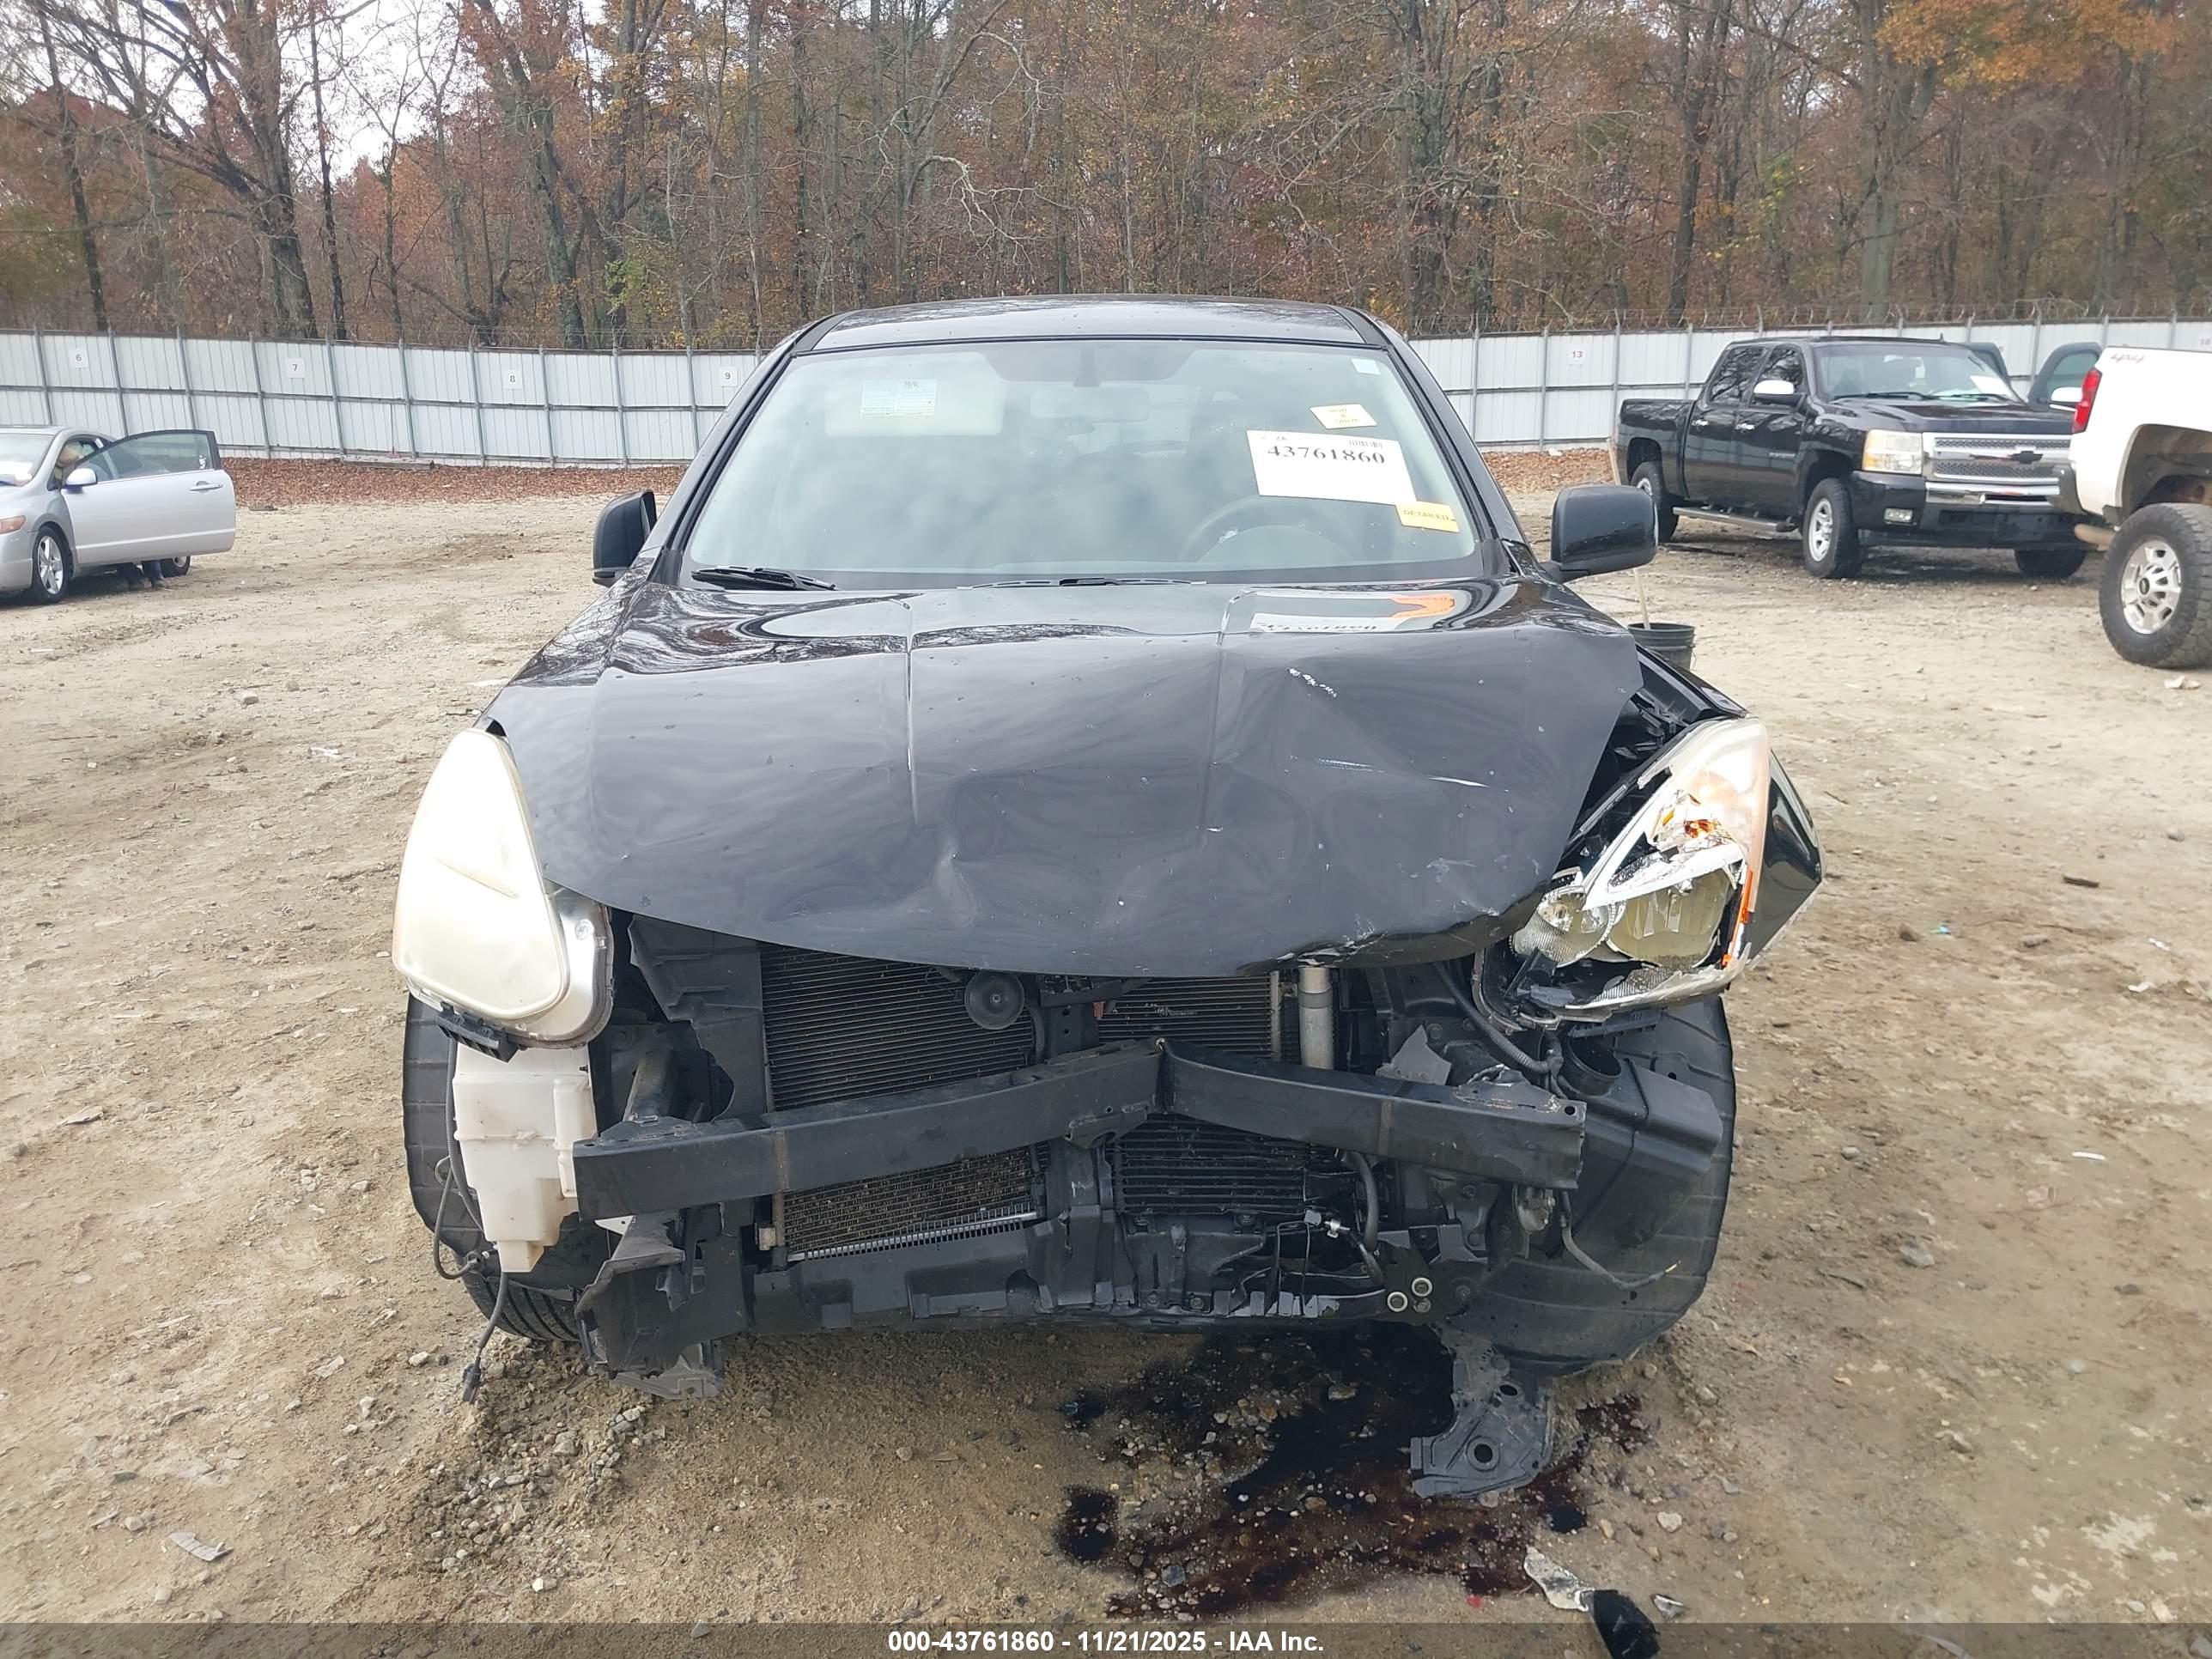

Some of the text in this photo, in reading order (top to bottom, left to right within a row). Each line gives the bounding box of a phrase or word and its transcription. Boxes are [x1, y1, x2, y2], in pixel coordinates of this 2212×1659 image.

[292, 363, 298, 372] 7
[509, 374, 516, 383] 8
[1267, 445, 1385, 464] 43761860
